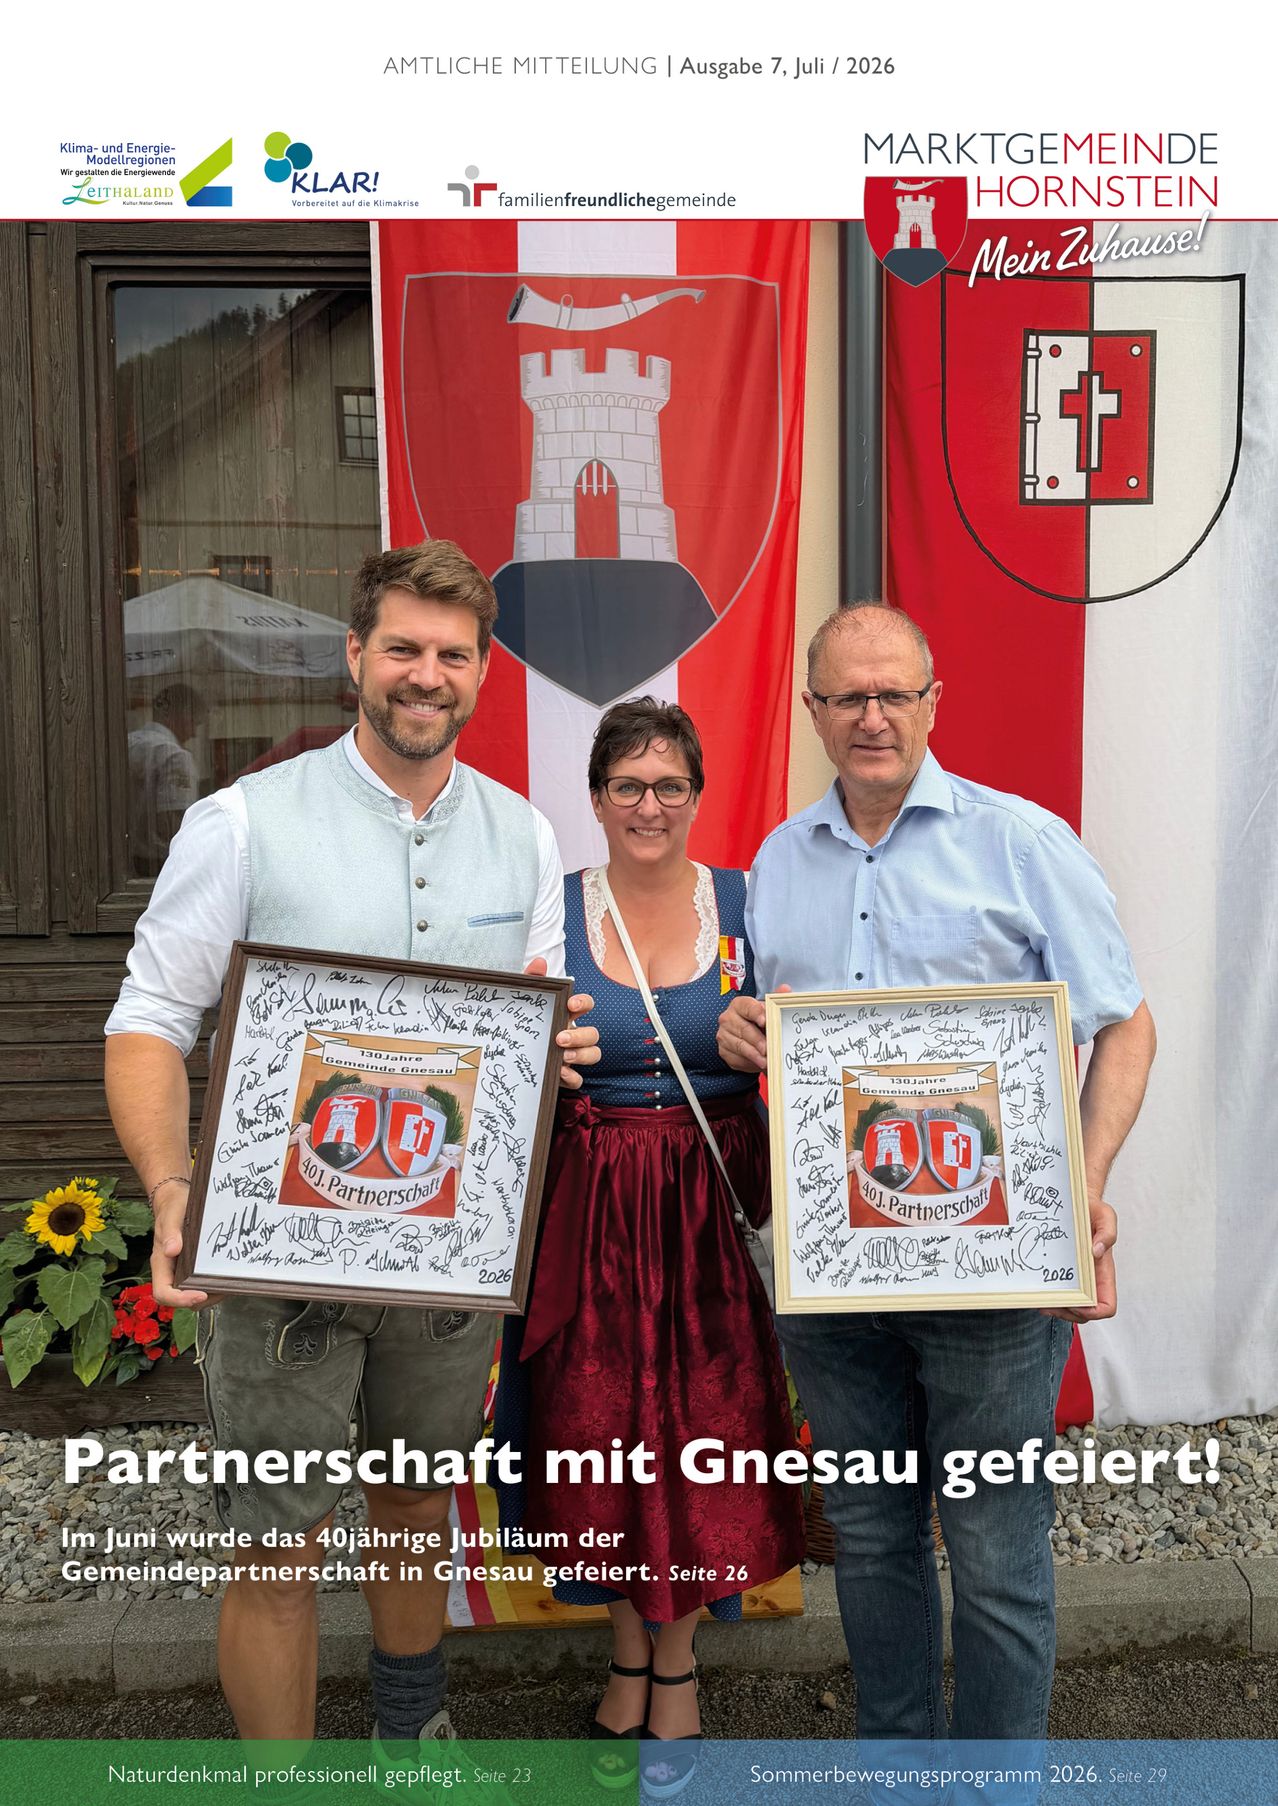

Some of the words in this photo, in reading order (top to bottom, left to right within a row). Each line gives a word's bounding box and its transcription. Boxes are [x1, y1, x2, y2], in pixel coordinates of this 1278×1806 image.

[325, 1056, 397, 1074] Gemeinde
[400, 1065, 454, 1075] Gnesau
[862, 1087, 926, 1096] Gemeinde
[928, 1084, 977, 1095] Gnesau
[327, 1175, 441, 1208] Partnerschaft
[888, 1186, 989, 1222] Partnerschaft
[478, 1268, 513, 1285] 2026
[1042, 1267, 1075, 1284] 2026
